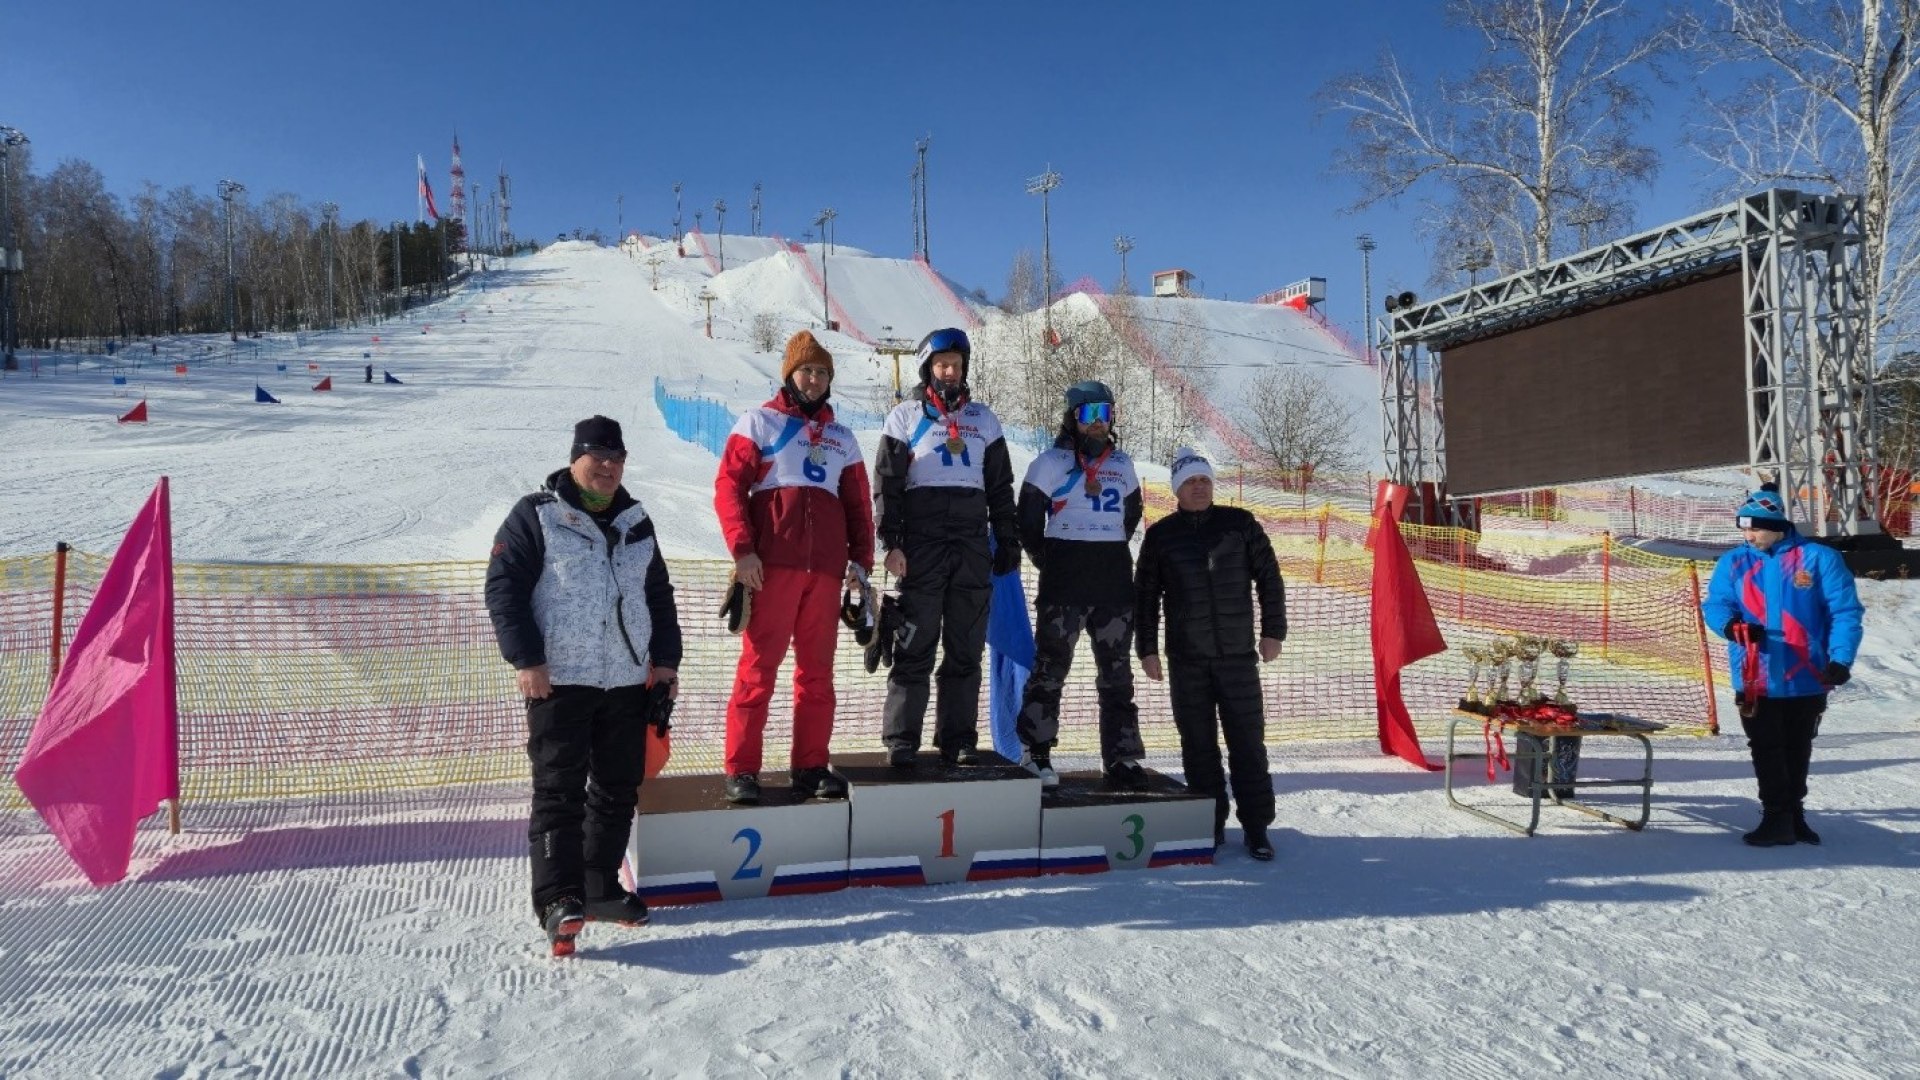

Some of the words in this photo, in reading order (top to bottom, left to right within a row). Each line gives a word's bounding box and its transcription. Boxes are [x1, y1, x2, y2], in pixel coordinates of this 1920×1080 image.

[803, 456, 827, 483] 6
[933, 443, 971, 467] 11
[1084, 488, 1121, 512] 12
[935, 808, 959, 859] 1
[1115, 813, 1146, 862] 3
[730, 827, 764, 881] 2
